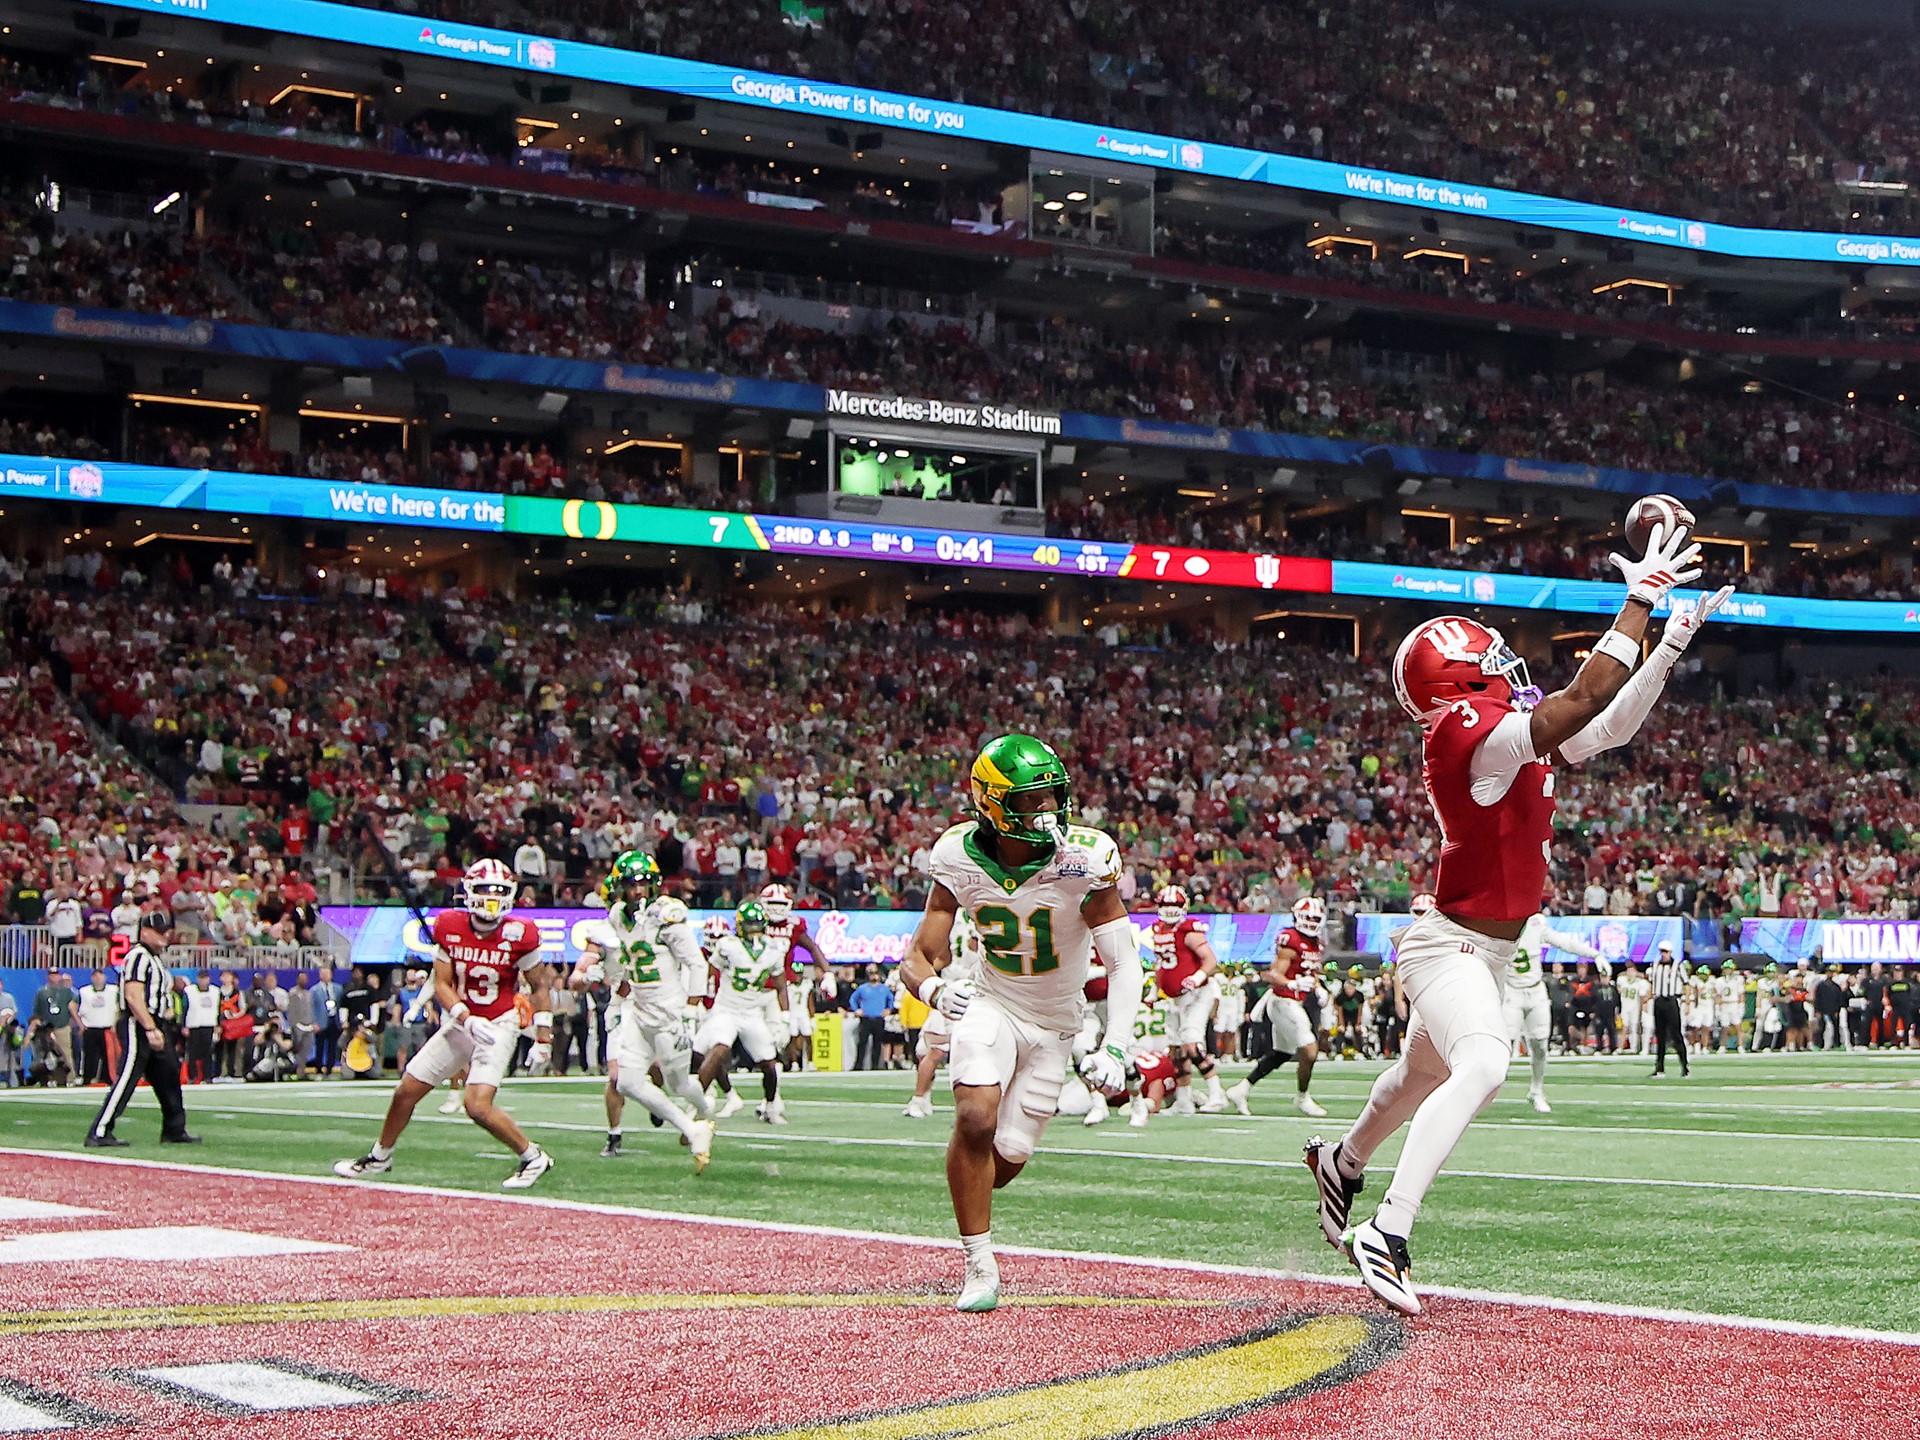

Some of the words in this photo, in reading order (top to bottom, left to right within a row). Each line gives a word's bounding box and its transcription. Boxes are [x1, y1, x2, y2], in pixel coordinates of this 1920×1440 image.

[436, 33, 478, 53] Georgia
[479, 40, 511, 57] Power
[732, 75, 796, 104] Georgia
[799, 85, 849, 111] Power
[853, 94, 867, 114] is
[870, 97, 904, 120] here
[907, 102, 931, 123] for
[934, 112, 964, 129] you
[1345, 171, 1383, 194] We're
[1385, 178, 1414, 199] here
[1416, 182, 1437, 202] for
[1438, 187, 1461, 206] the
[1462, 192, 1488, 210] win
[1836, 239, 1889, 260] Georgia
[828, 389, 978, 427] Mercedes-Benz
[981, 405, 1061, 435] Stadium
[7, 469, 48, 487] Power
[329, 487, 388, 515] We're
[392, 493, 437, 518] here
[439, 496, 471, 521] for
[473, 500, 506, 524] the
[562, 499, 618, 540] O
[708, 516, 730, 543] 7
[773, 525, 814, 545] 2ND
[817, 528, 834, 547] &
[900, 535, 915, 553] 8
[935, 535, 994, 564] 0:41
[1032, 544, 1061, 566] 40
[1075, 554, 1110, 573] 1ST
[1152, 551, 1171, 576] 7
[1741, 600, 1766, 618] win
[1451, 699, 1480, 728] 3
[109, 933, 130, 967] 2
[975, 903, 1060, 977] 21
[1822, 923, 1920, 960] INDIAN
[448, 945, 512, 965] INDIANA
[455, 961, 500, 1006] 13
[817, 1028, 830, 1059] FOR
